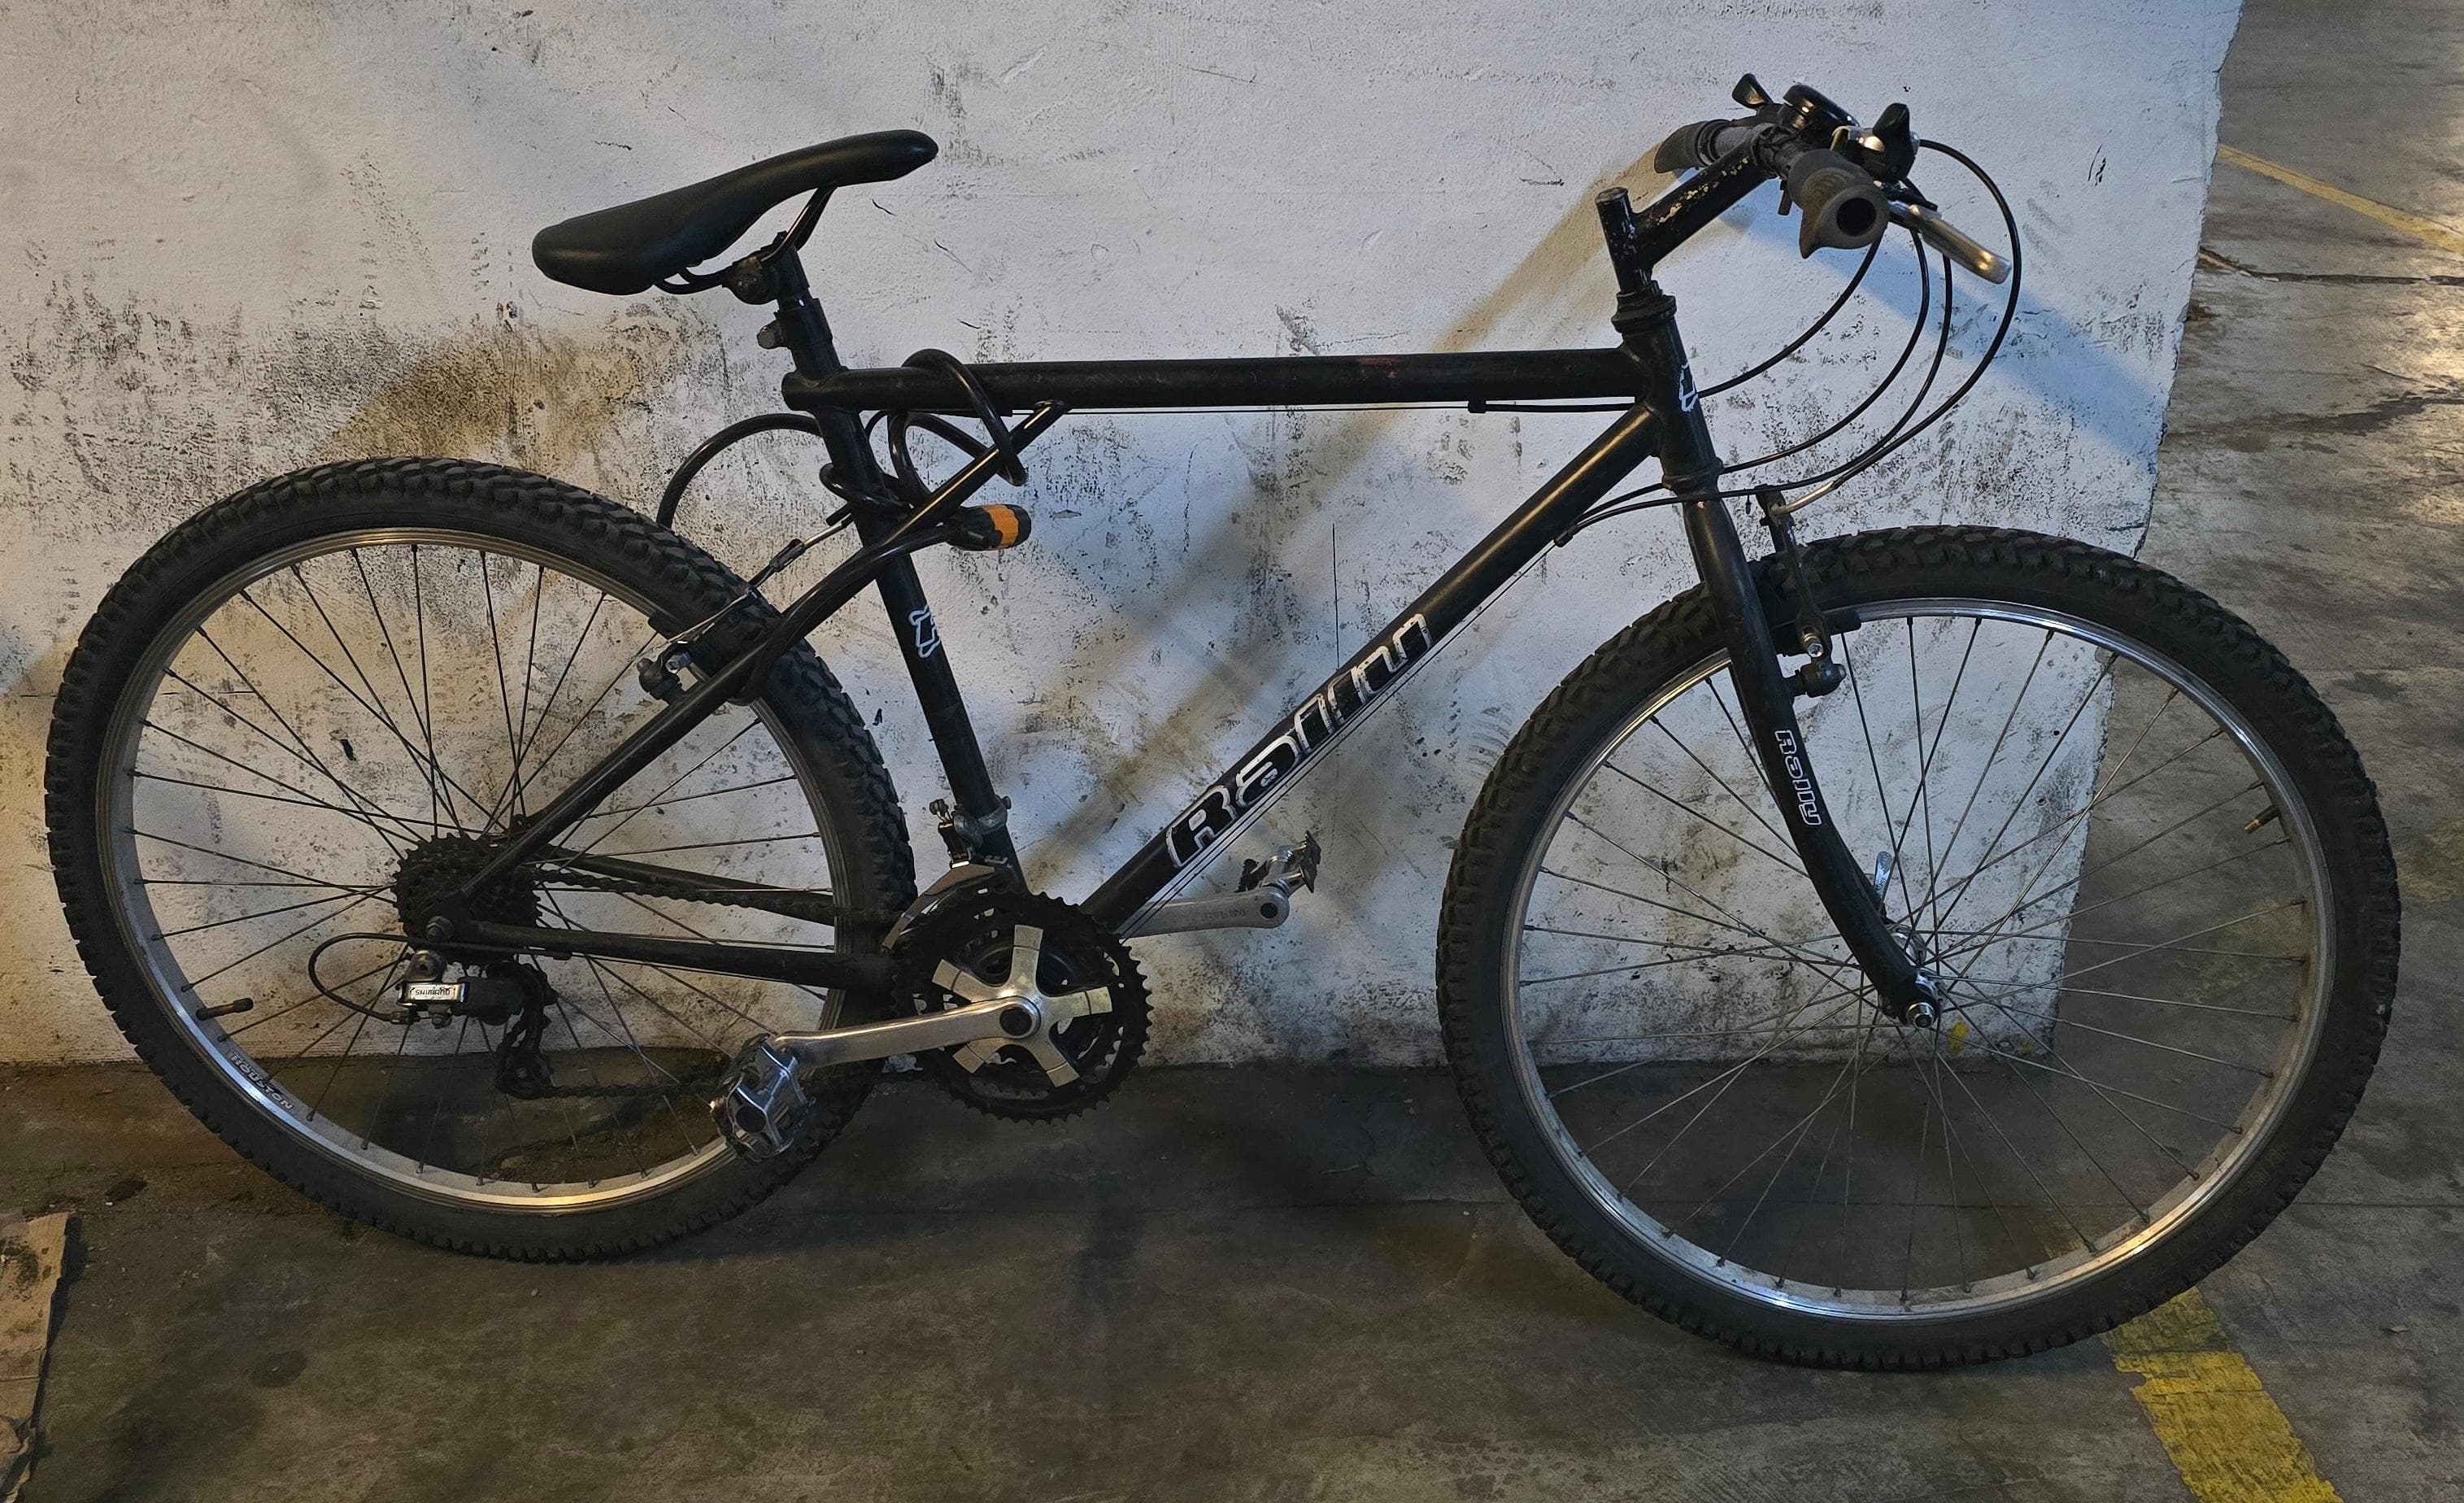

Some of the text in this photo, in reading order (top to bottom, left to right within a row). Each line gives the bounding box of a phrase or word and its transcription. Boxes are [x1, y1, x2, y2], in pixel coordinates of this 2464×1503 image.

[1774, 730, 1822, 826] Rally
[415, 987, 451, 996] SHIMANO
[230, 1052, 294, 1110] HOUSTON
